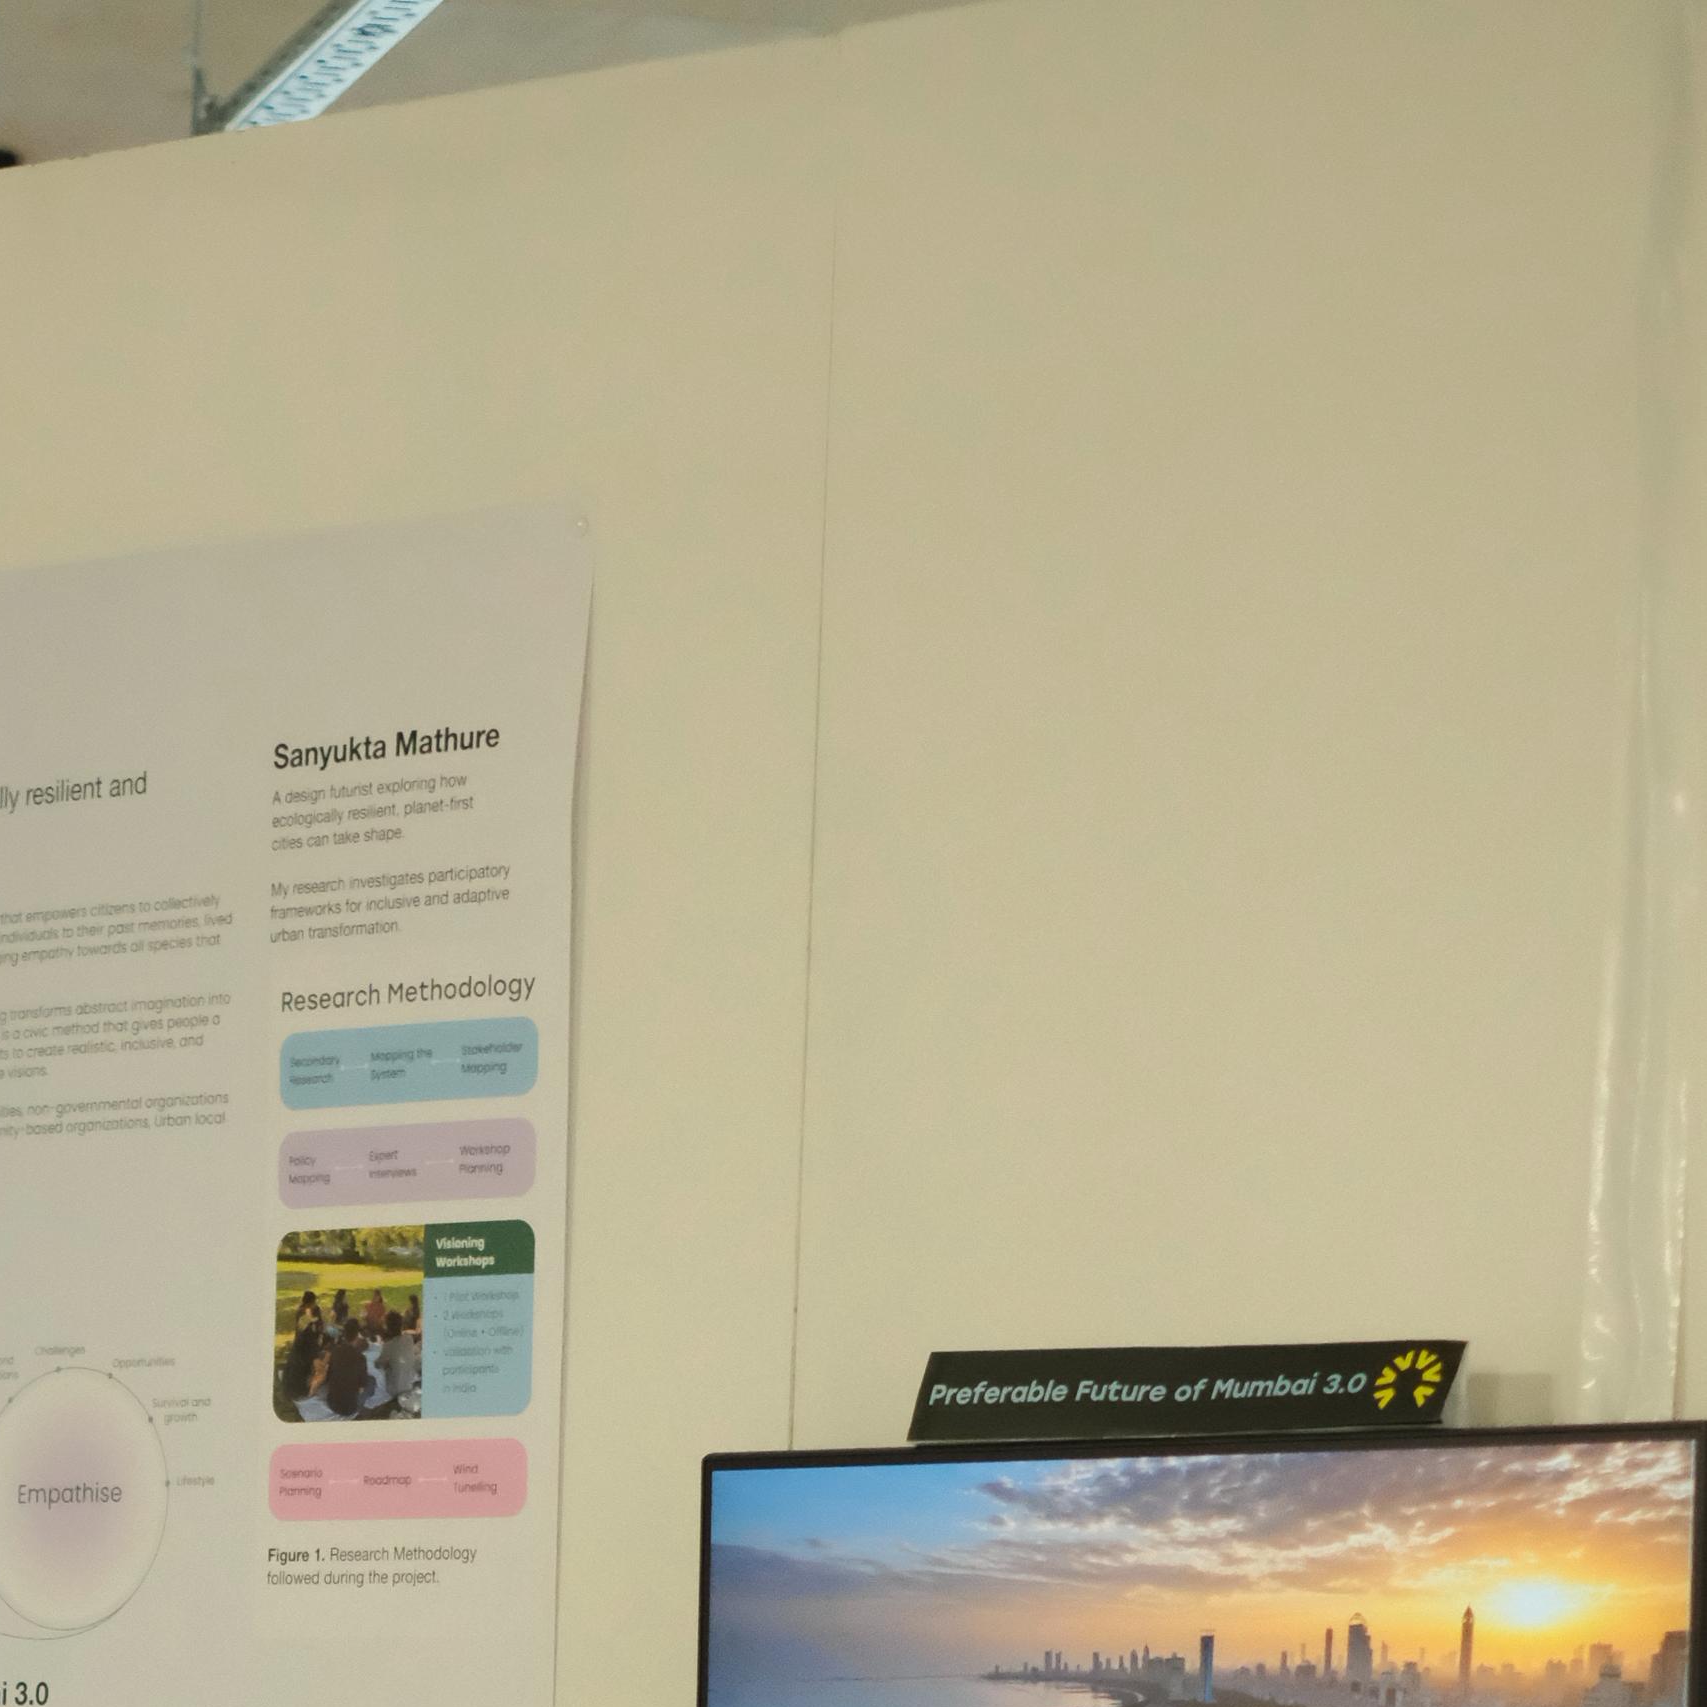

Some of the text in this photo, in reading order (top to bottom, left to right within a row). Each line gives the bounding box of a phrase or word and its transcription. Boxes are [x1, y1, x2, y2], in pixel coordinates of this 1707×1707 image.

[273, 727, 499, 770] Sanyukta Mathure
[25, 777, 102, 805] resilient
[109, 771, 147, 797] and
[281, 974, 535, 1012] Research Methodology
[435, 1236, 484, 1251] Visioning
[435, 1255, 494, 1268] Workshops
[929, 1371, 1367, 1405] Preferable Future of Mumbai 3.0
[17, 1482, 122, 1510] Empathise
[267, 1546, 477, 1565] Figure 1. Research Methodology
[267, 1570, 439, 1588] followed during the project.
[15, 1681, 48, 1706] 3.0
